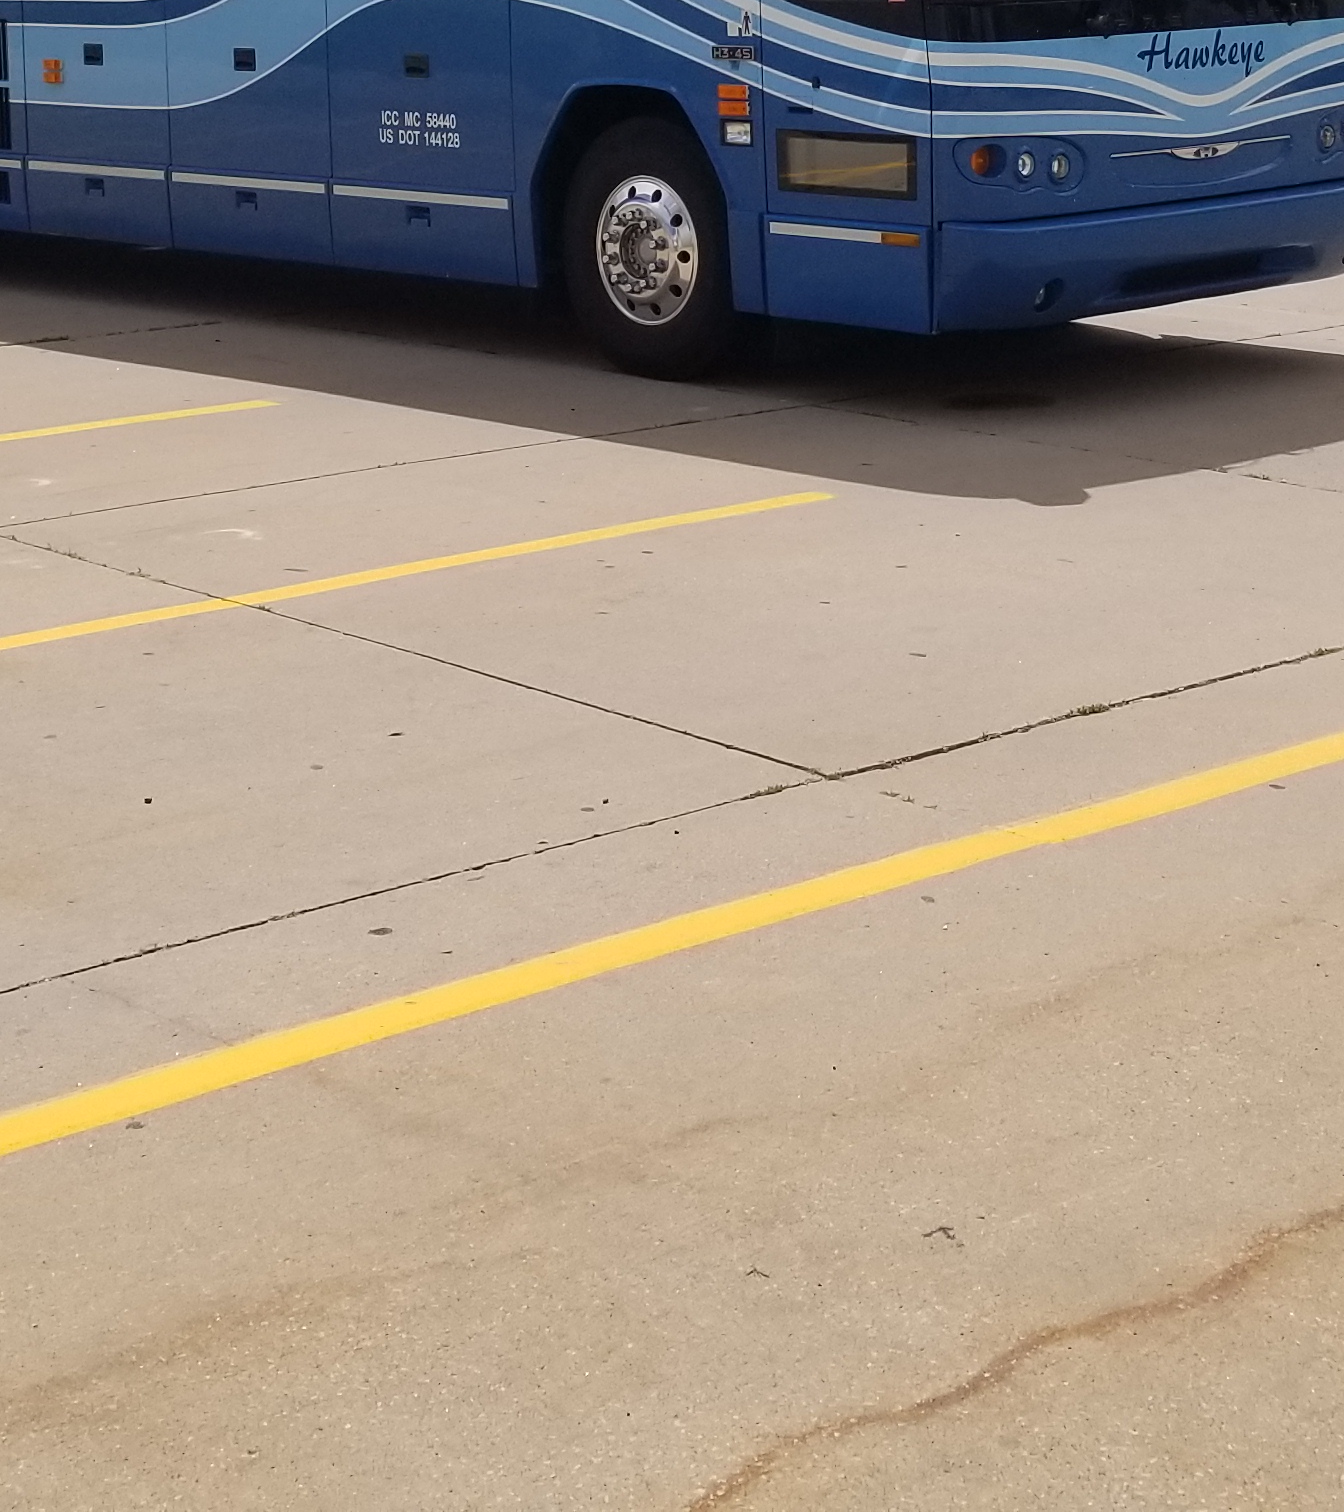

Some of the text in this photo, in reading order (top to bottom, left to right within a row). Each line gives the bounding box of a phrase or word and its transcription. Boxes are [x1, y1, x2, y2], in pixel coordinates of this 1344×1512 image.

[1136, 28, 1265, 78] Hawkeye
[381, 110, 457, 129] ICC MC 58440
[379, 128, 460, 149] US DOT 144128
